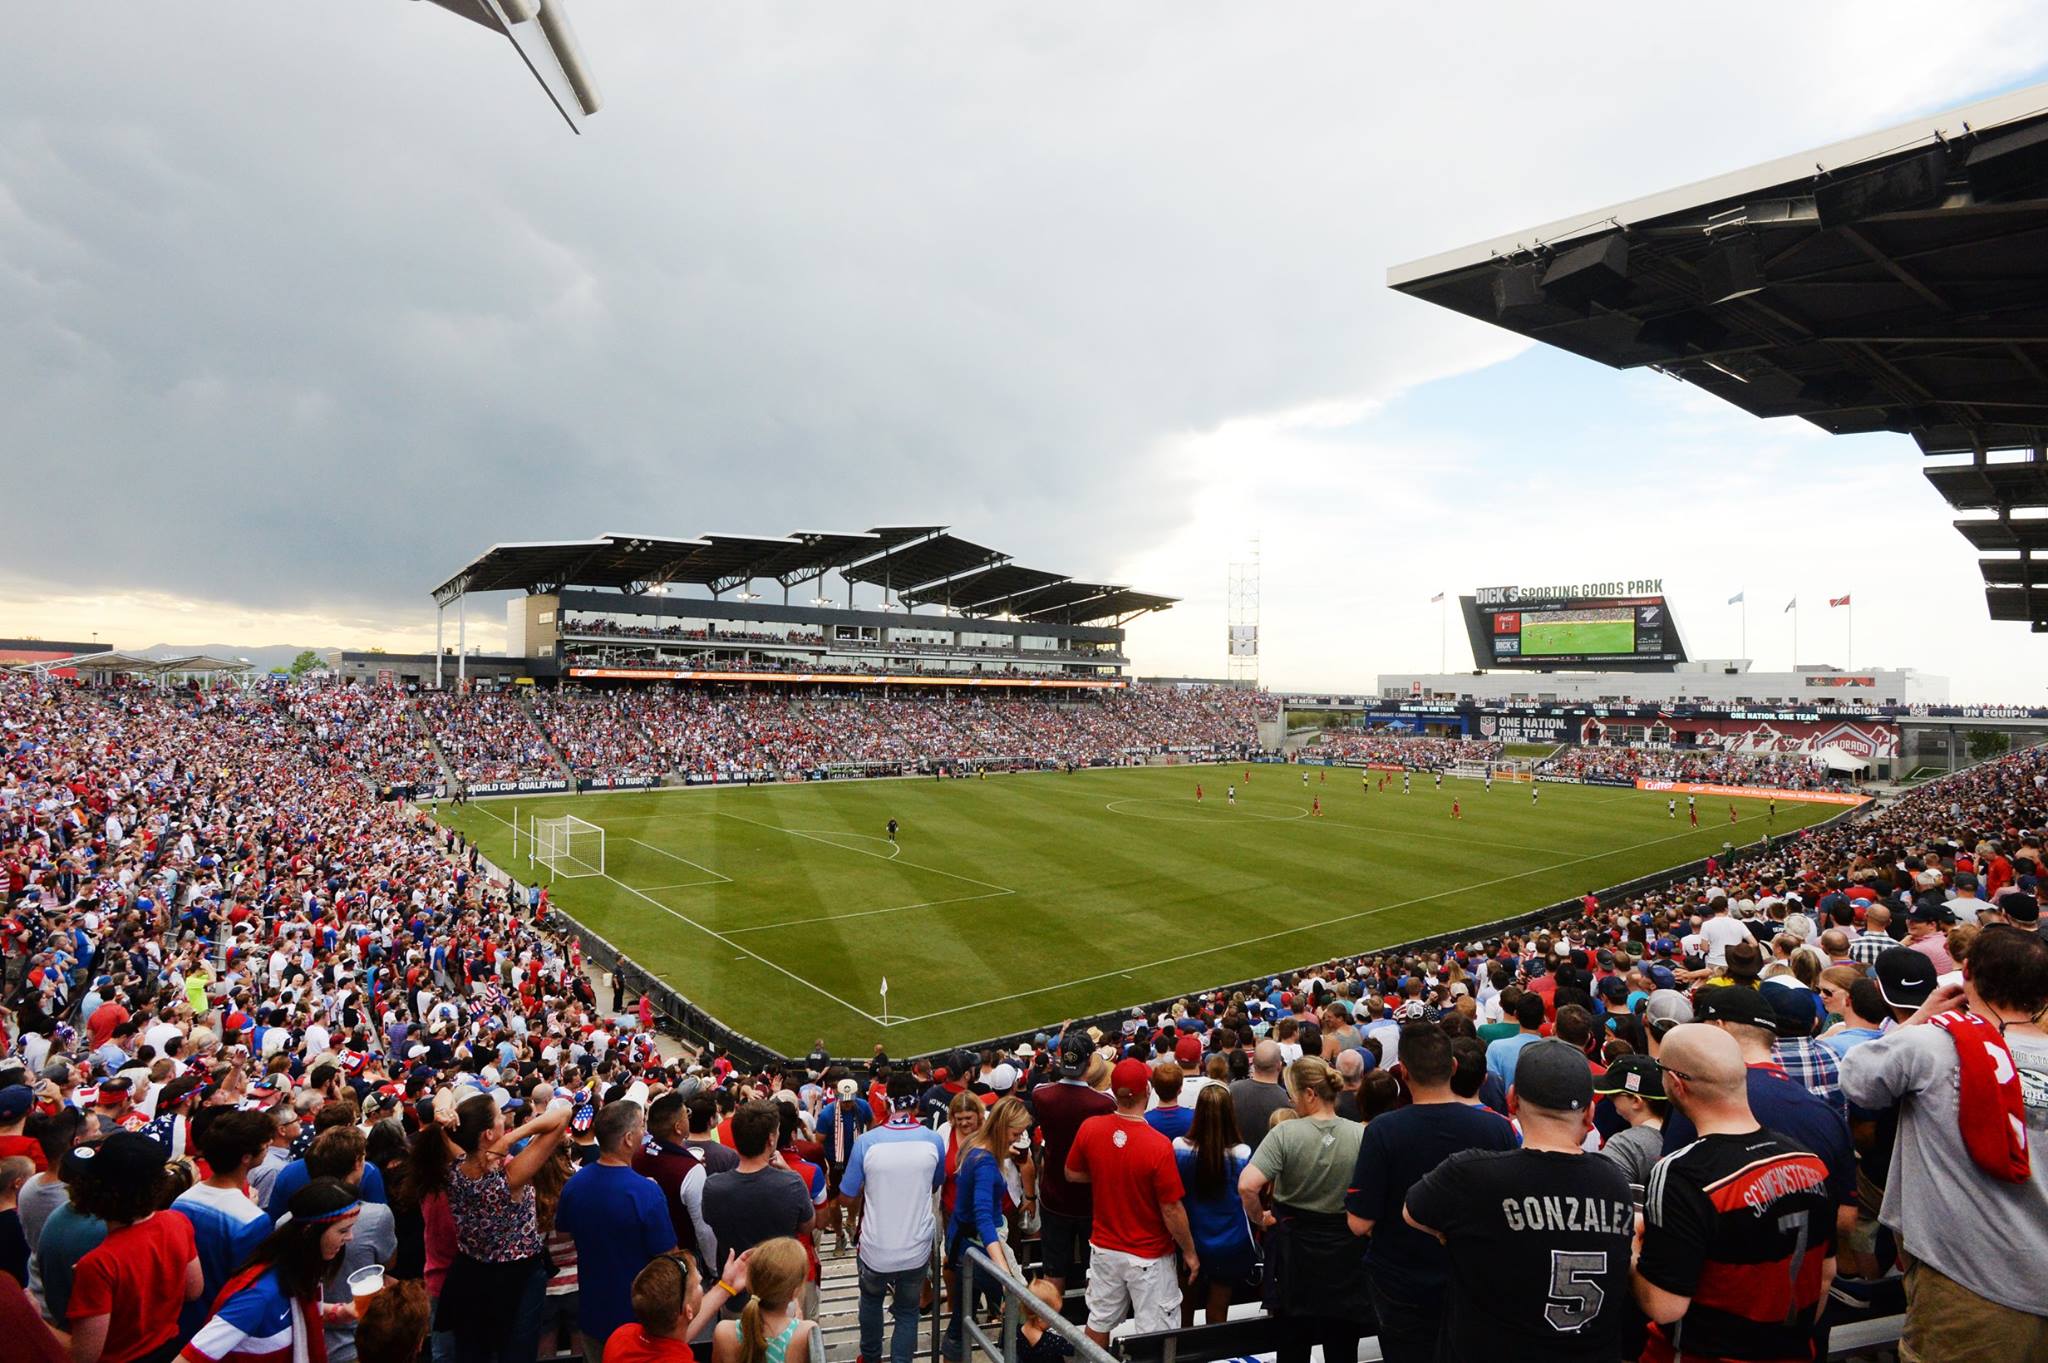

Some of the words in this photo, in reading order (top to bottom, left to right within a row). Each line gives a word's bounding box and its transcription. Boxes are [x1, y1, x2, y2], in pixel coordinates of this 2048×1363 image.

[1476, 586, 1518, 604] DICK'S
[1521, 584, 1579, 601] SPORTING
[1582, 581, 1624, 597] GOODS
[1628, 578, 1663, 594] PARK
[1720, 705, 1748, 713] TEAM.
[1816, 706, 1837, 714] UNA
[1963, 709, 1980, 717] UN
[1499, 717, 1521, 728] ONE
[1523, 718, 1568, 730] NATION.
[1797, 713, 1820, 721] TEAM.
[1499, 728, 1521, 738] ONE
[1648, 742, 1673, 750] TEAM.
[467, 784, 499, 793] WORLD
[500, 783, 517, 791] CUP
[519, 780, 566, 790] QUALIFYING
[1645, 781, 1676, 791] Cutter
[929, 1098, 950, 1113] HOWAR
[1744, 1164, 1829, 1219] SCHWEINSTEIGE
[1502, 1196, 1634, 1236] GONZALEZ
[1778, 1210, 1809, 1329] 7
[1544, 1250, 1607, 1331] 5
